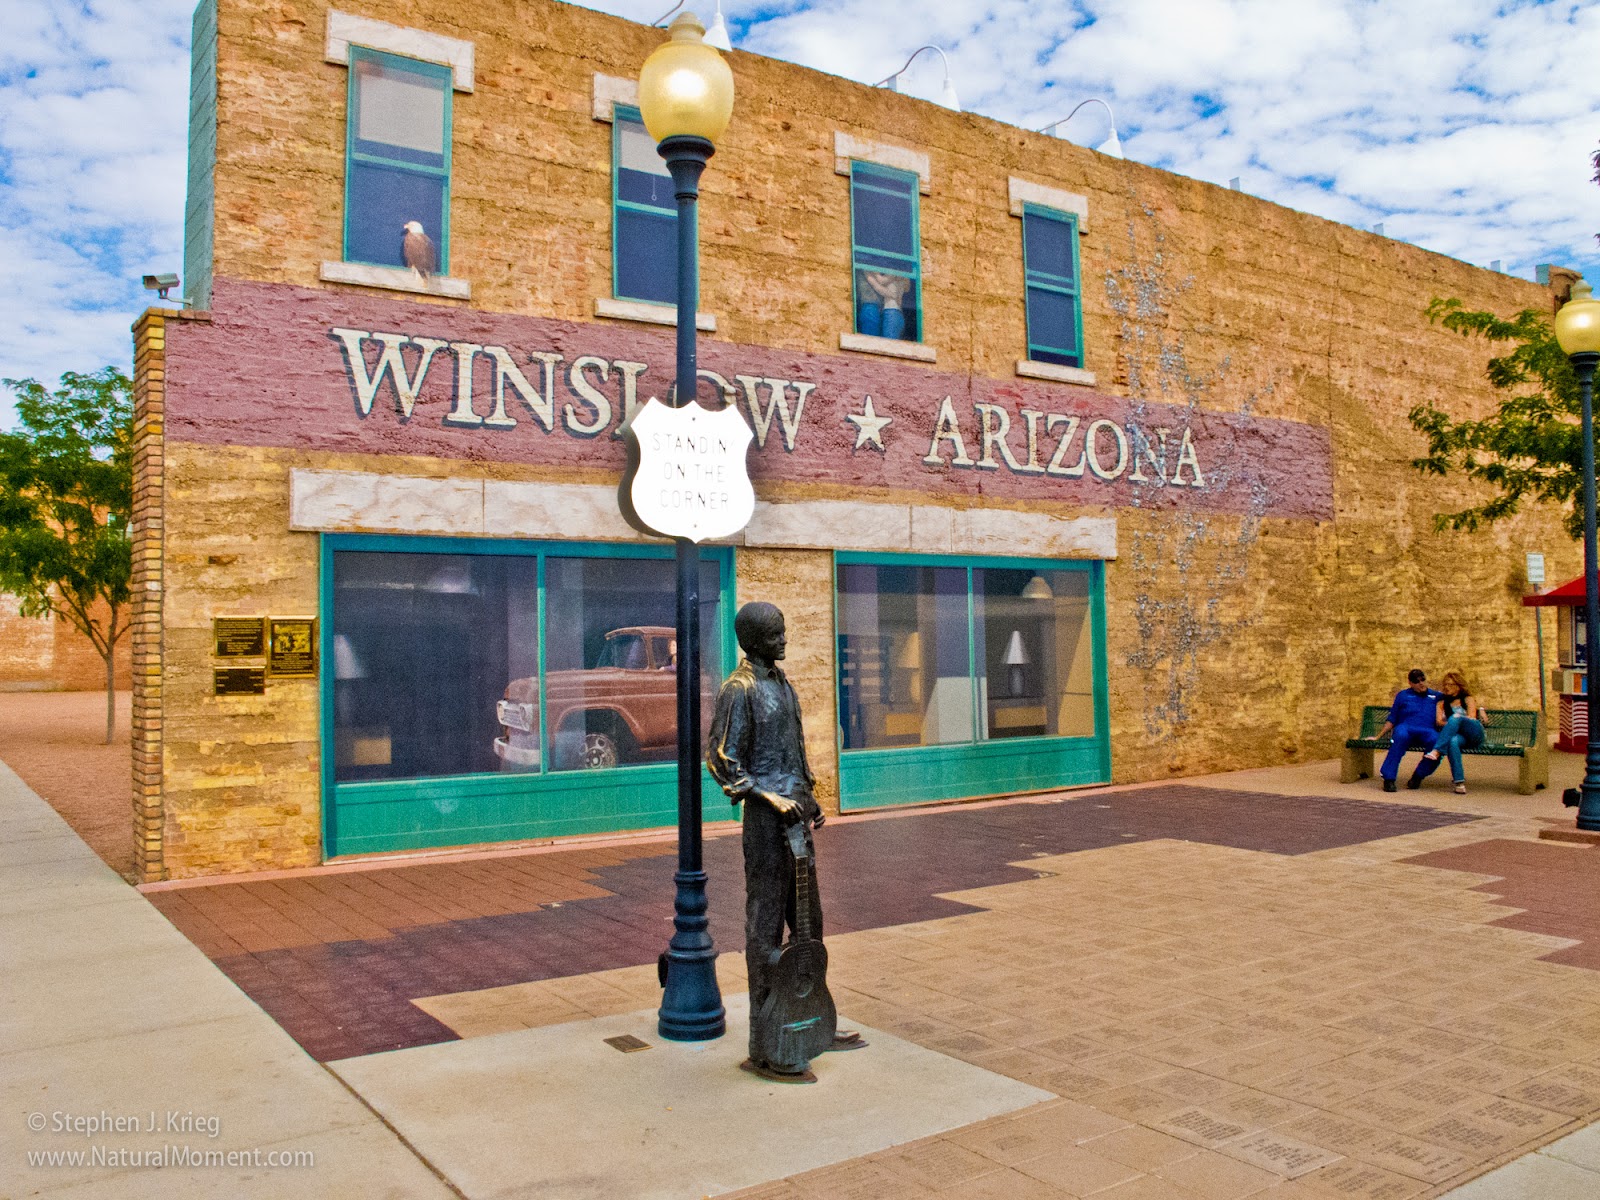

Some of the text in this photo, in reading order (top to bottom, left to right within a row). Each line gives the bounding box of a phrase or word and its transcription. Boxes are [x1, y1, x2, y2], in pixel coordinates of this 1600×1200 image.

[922, 395, 1205, 488] ARIZONA
[663, 462, 726, 483] ON THE
[660, 489, 729, 511] CORNER
